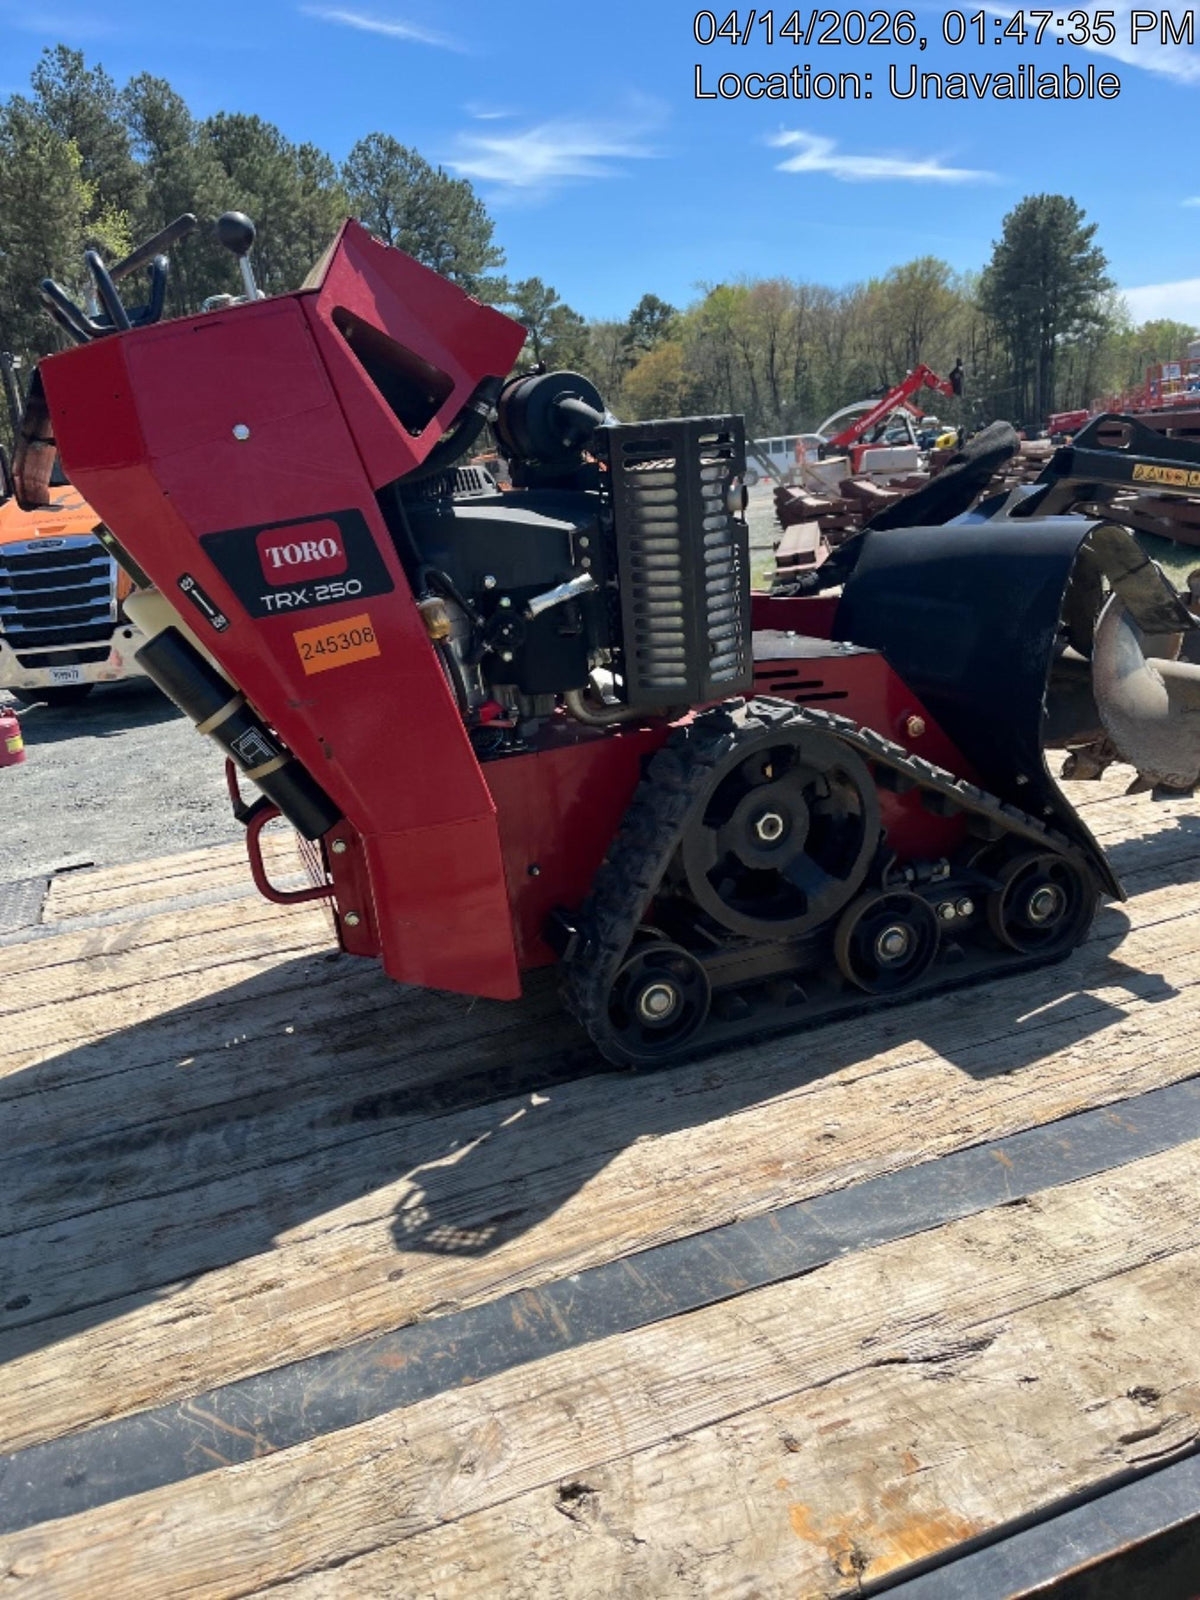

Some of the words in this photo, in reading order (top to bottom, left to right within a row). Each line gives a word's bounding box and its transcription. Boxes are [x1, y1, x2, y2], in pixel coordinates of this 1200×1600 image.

[265, 537, 338, 569] TORO
[260, 579, 363, 611] TRX-250
[301, 627, 375, 660] 245308
